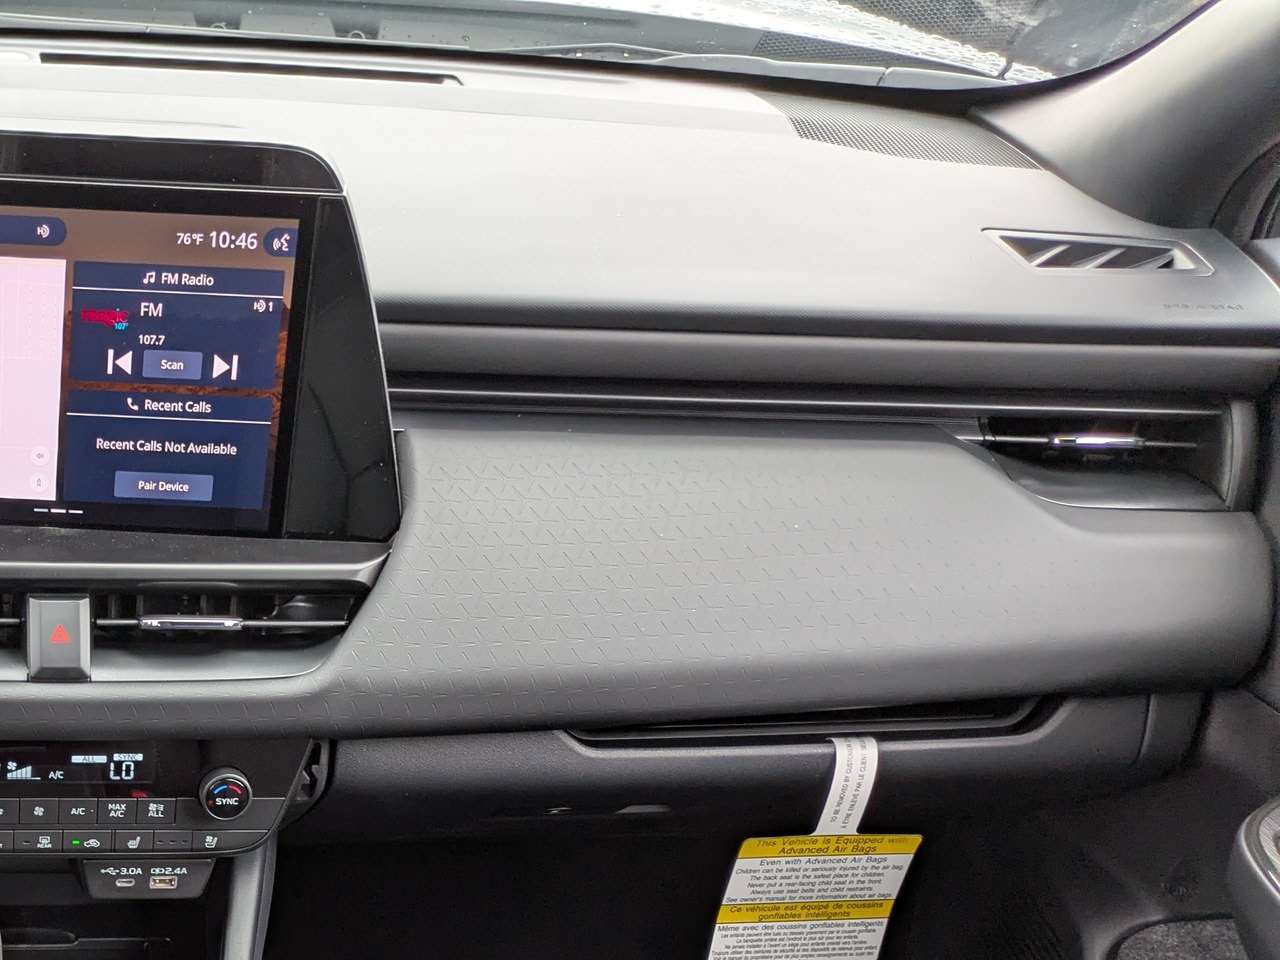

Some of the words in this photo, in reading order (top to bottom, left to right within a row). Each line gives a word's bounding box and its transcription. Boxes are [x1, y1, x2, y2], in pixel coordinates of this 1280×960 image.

[176, 232, 204, 246] 76°F
[209, 230, 258, 250] 10:46
[161, 272, 178, 285] FM
[182, 274, 214, 286] Radio
[140, 302, 163, 317] FM
[138, 334, 165, 346] 107.7
[160, 360, 184, 371] Scan
[144, 400, 183, 412] Recent
[185, 401, 212, 413] Calls
[96, 438, 134, 451] Recent
[137, 440, 163, 452] Calls
[164, 442, 185, 454] Not
[187, 442, 237, 456] Available
[138, 481, 157, 491] Pair
[159, 482, 189, 492] Device
[48, 771, 64, 779] A/C
[71, 807, 86, 816] A/C
[782, 838, 817, 846] Vehicle
[835, 837, 883, 846] Equipped
[778, 846, 828, 855] Advanced
[851, 845, 876, 854] Bags
